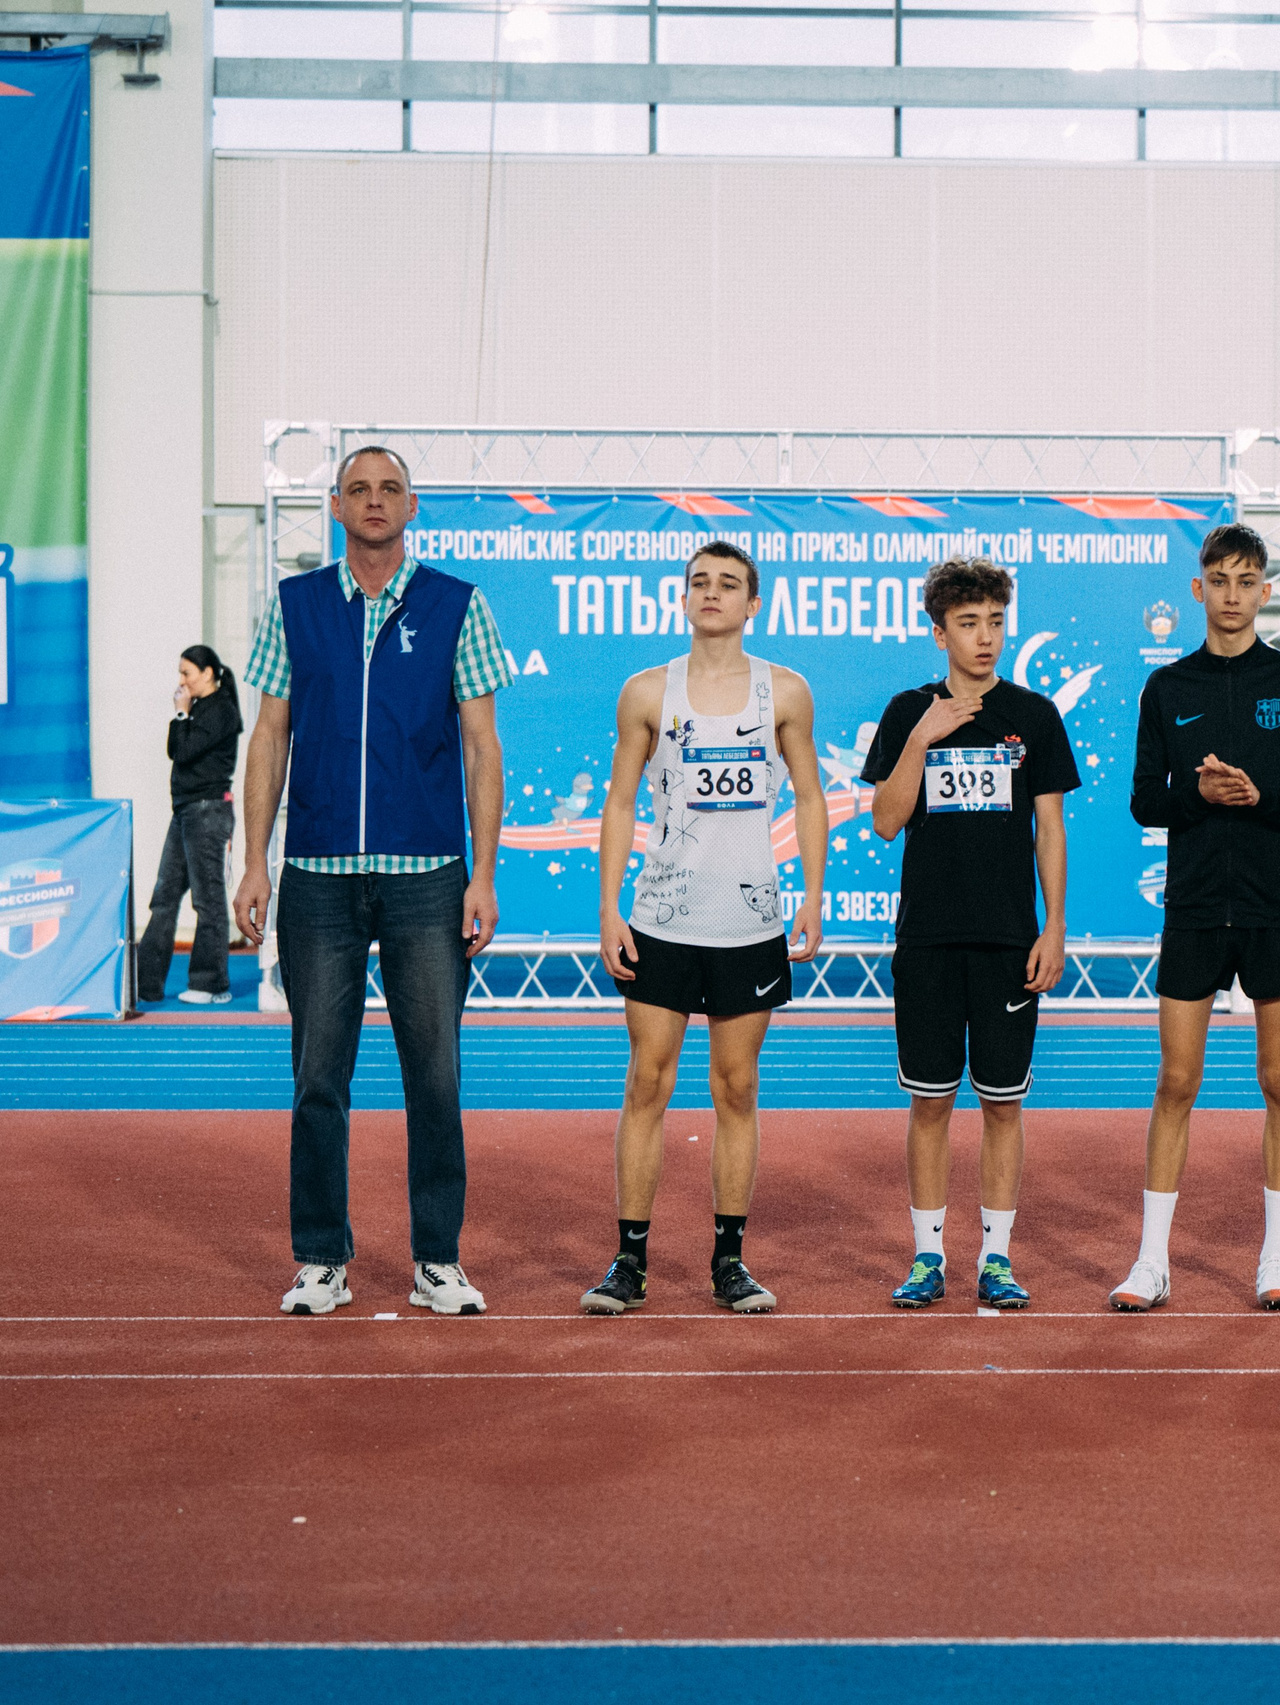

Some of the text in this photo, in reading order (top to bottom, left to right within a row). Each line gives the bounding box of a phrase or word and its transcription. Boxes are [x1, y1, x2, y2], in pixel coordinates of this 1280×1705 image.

[404, 525, 577, 561] ВСЕРОССИЙСКИЕ
[757, 532, 786, 562] НА
[792, 532, 868, 563] ПРИЗЫ
[873, 528, 1033, 563] ОЛИМПИЙСКОЙ
[1038, 533, 1168, 564] ЧЕМПИОНКИ
[552, 567, 1018, 644] ТАТЬЯ ЛЕБЕДЕ
[696, 767, 754, 796] 368
[939, 770, 996, 799] 398
